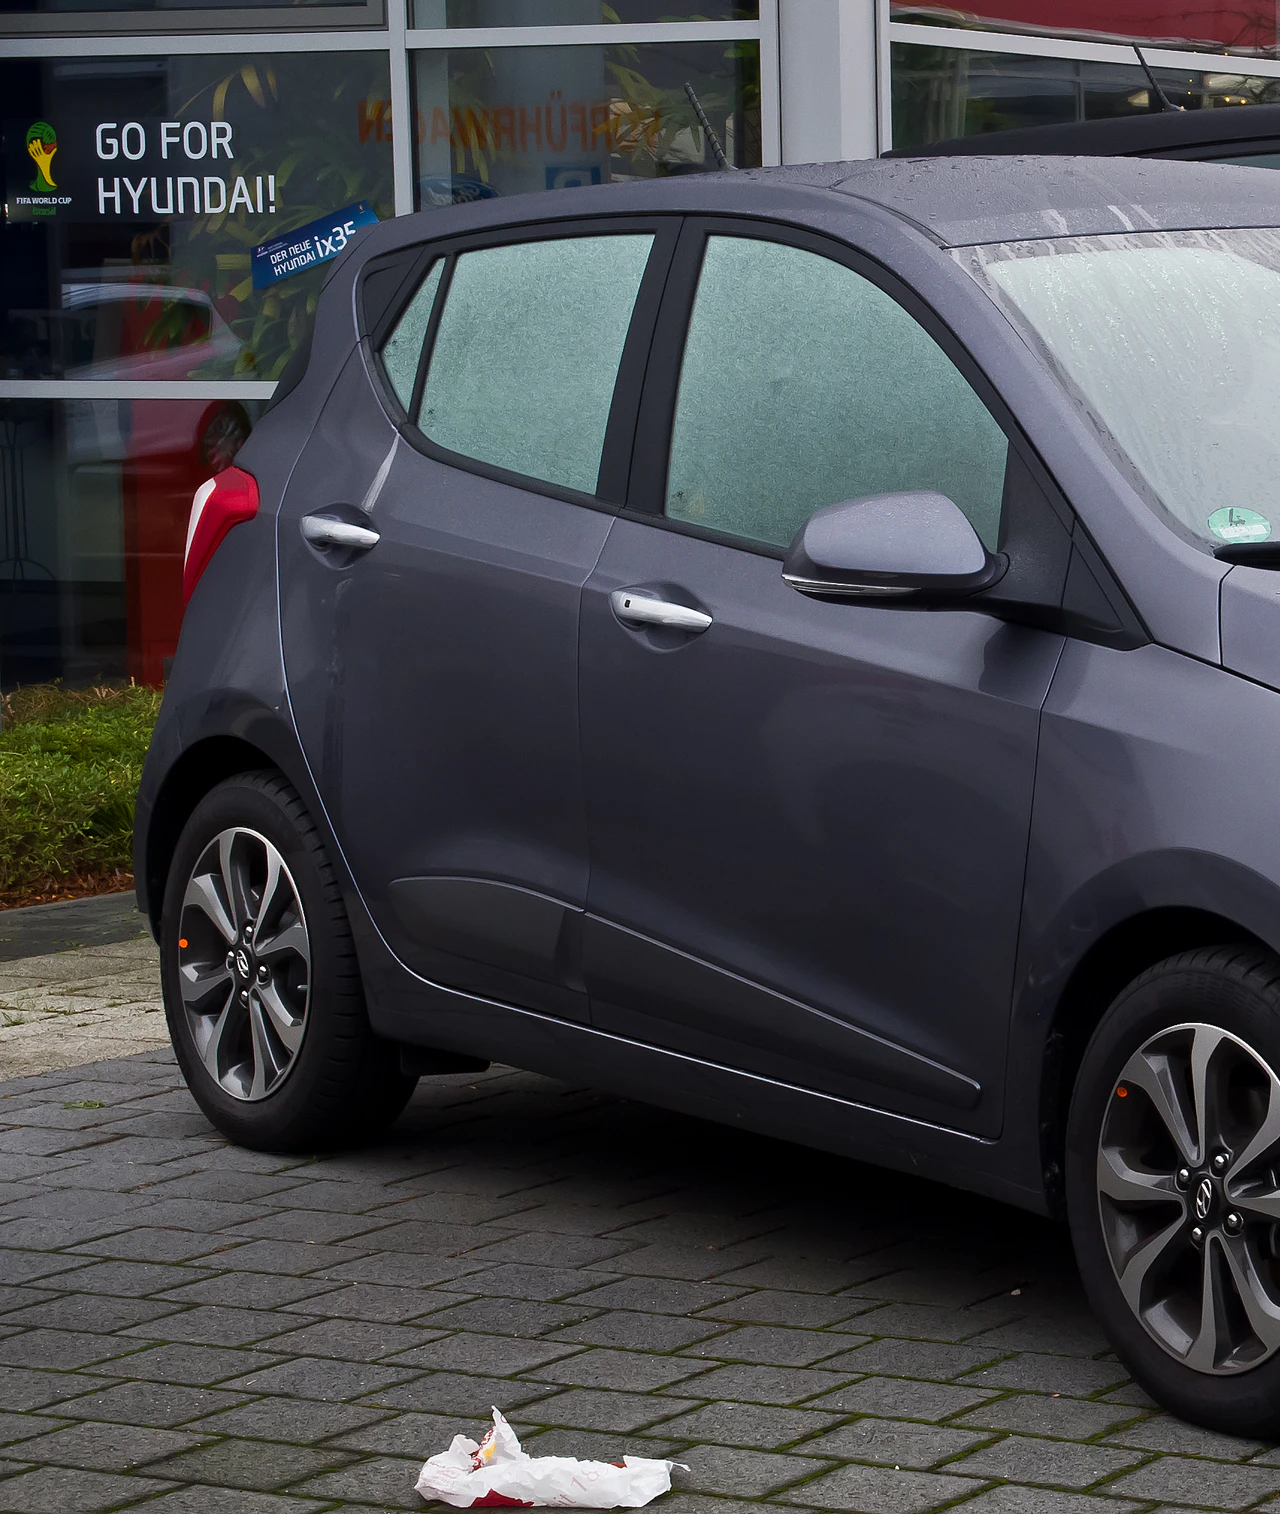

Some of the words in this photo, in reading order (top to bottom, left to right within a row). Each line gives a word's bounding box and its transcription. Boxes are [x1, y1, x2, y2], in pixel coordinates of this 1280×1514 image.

[95, 121, 147, 160] GO
[160, 121, 234, 160] FOR
[97, 174, 276, 214] HYUNDAI!
[269, 249, 288, 265] DER
[288, 239, 312, 256] NEUE
[273, 250, 317, 276] HYUNDAI
